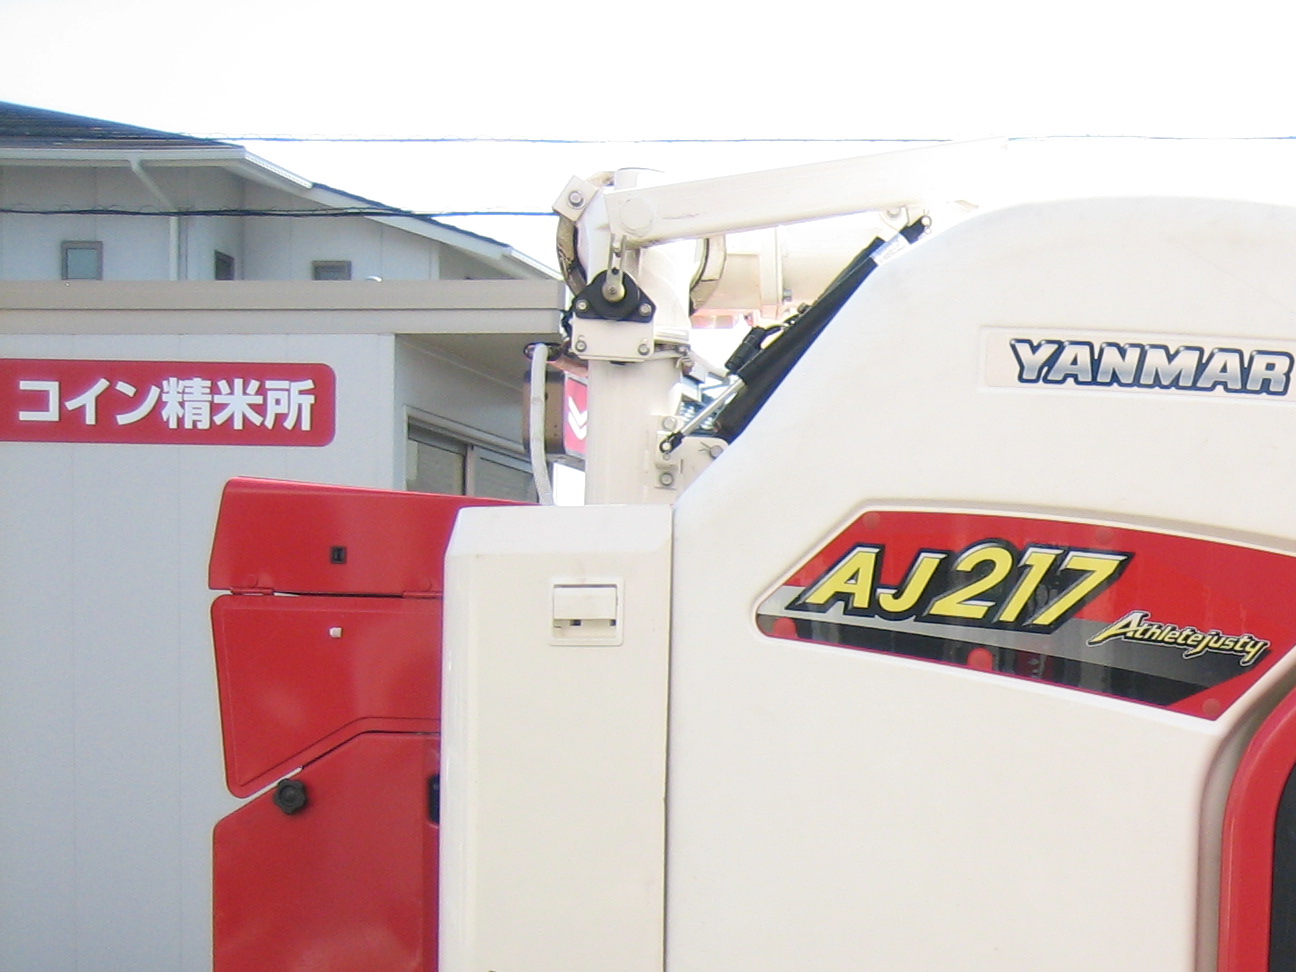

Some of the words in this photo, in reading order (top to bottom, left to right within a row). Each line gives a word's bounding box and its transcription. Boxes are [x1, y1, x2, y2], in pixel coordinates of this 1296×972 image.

[1009, 338, 1295, 397] YANMAR
[18, 377, 316, 431] コイン精米所
[790, 539, 1130, 631] AJ217
[1089, 611, 1268, 664] Athletejusty
